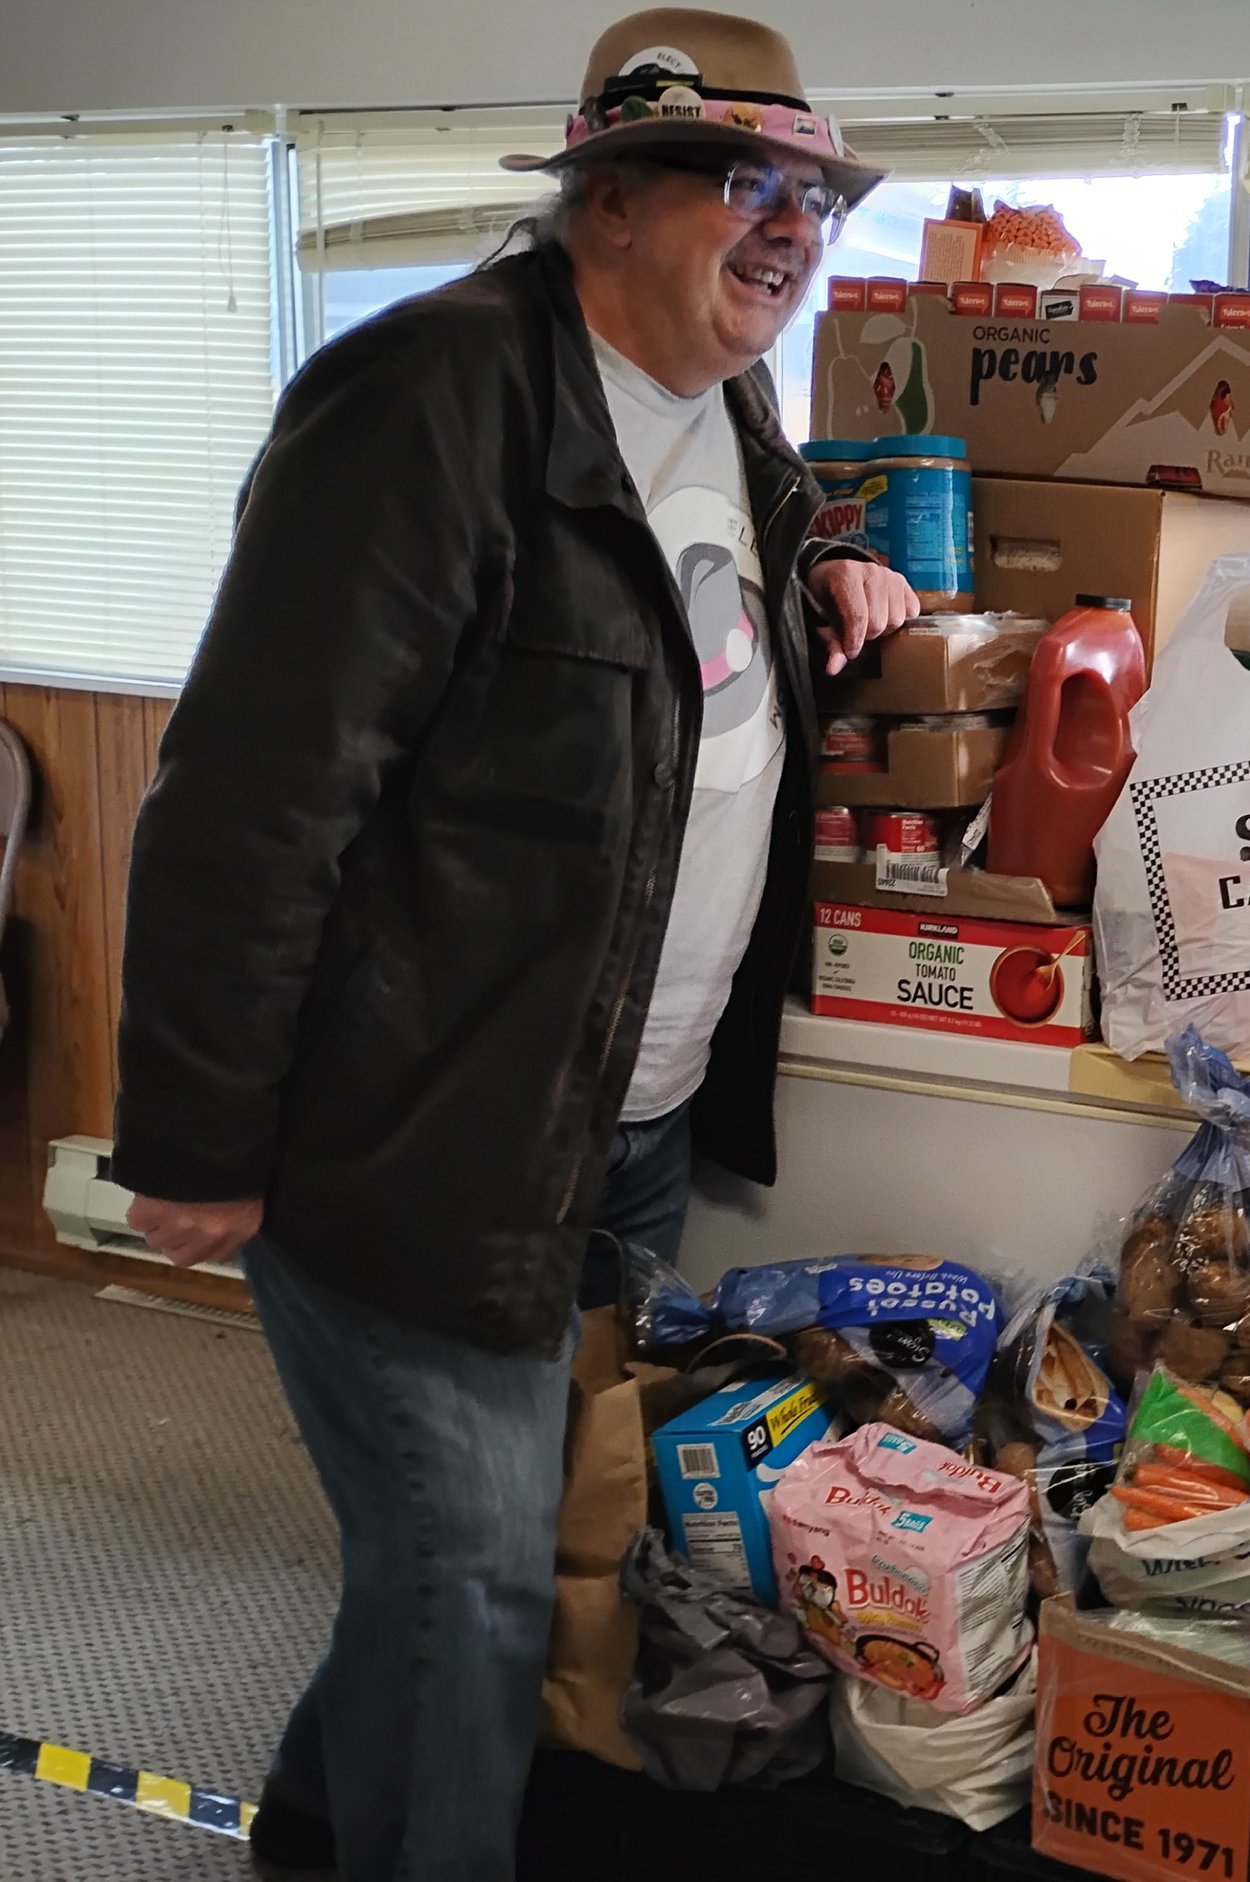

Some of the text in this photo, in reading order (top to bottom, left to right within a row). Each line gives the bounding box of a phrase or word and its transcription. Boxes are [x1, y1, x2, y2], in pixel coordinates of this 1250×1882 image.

[661, 103, 702, 118] RESIST
[973, 326, 1051, 344] ORGANIC
[970, 347, 1098, 405] pears
[808, 503, 863, 539] KIPPY
[819, 907, 862, 927] 12 CANS
[919, 923, 958, 935] KIRKLAND
[908, 941, 965, 965] ORGANIC
[915, 963, 956, 982] TOMATO
[896, 979, 974, 1010] SAUCE
[849, 1276, 996, 1321] Potatoes
[866, 1297, 978, 1328] Russet
[747, 1425, 766, 1450] 90
[939, 1459, 1003, 1494] Buldak
[844, 1568, 929, 1618] Buldak
[1084, 1693, 1174, 1741] The
[1047, 1736, 1234, 1801] Original
[1046, 1790, 1235, 1878] SINCE 1971
